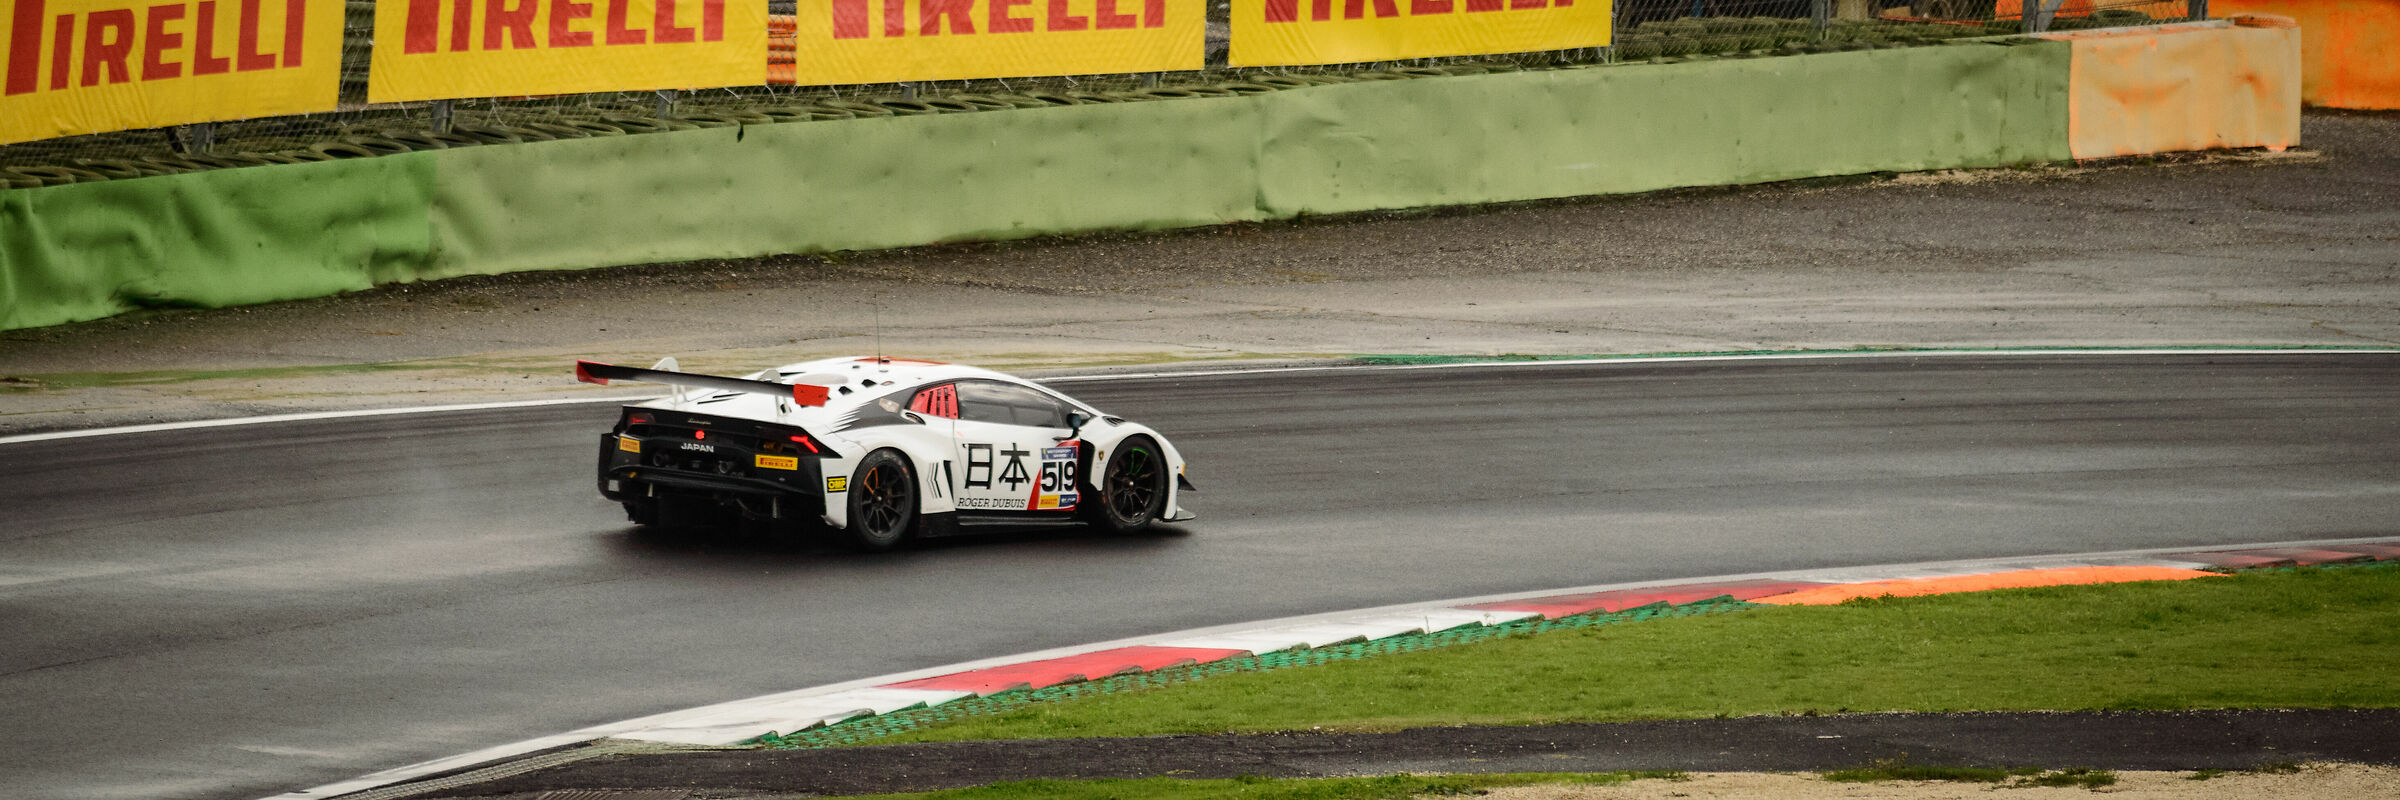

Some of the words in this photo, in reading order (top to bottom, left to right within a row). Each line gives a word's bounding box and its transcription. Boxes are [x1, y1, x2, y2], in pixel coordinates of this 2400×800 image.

[404, 0, 725, 54] IRELLI
[681, 443, 714, 452] JAPAN
[964, 442, 1031, 491] 日本
[1041, 460, 1076, 492] 519
[958, 497, 990, 507] ROGER
[992, 498, 1025, 508] DUBUIS
